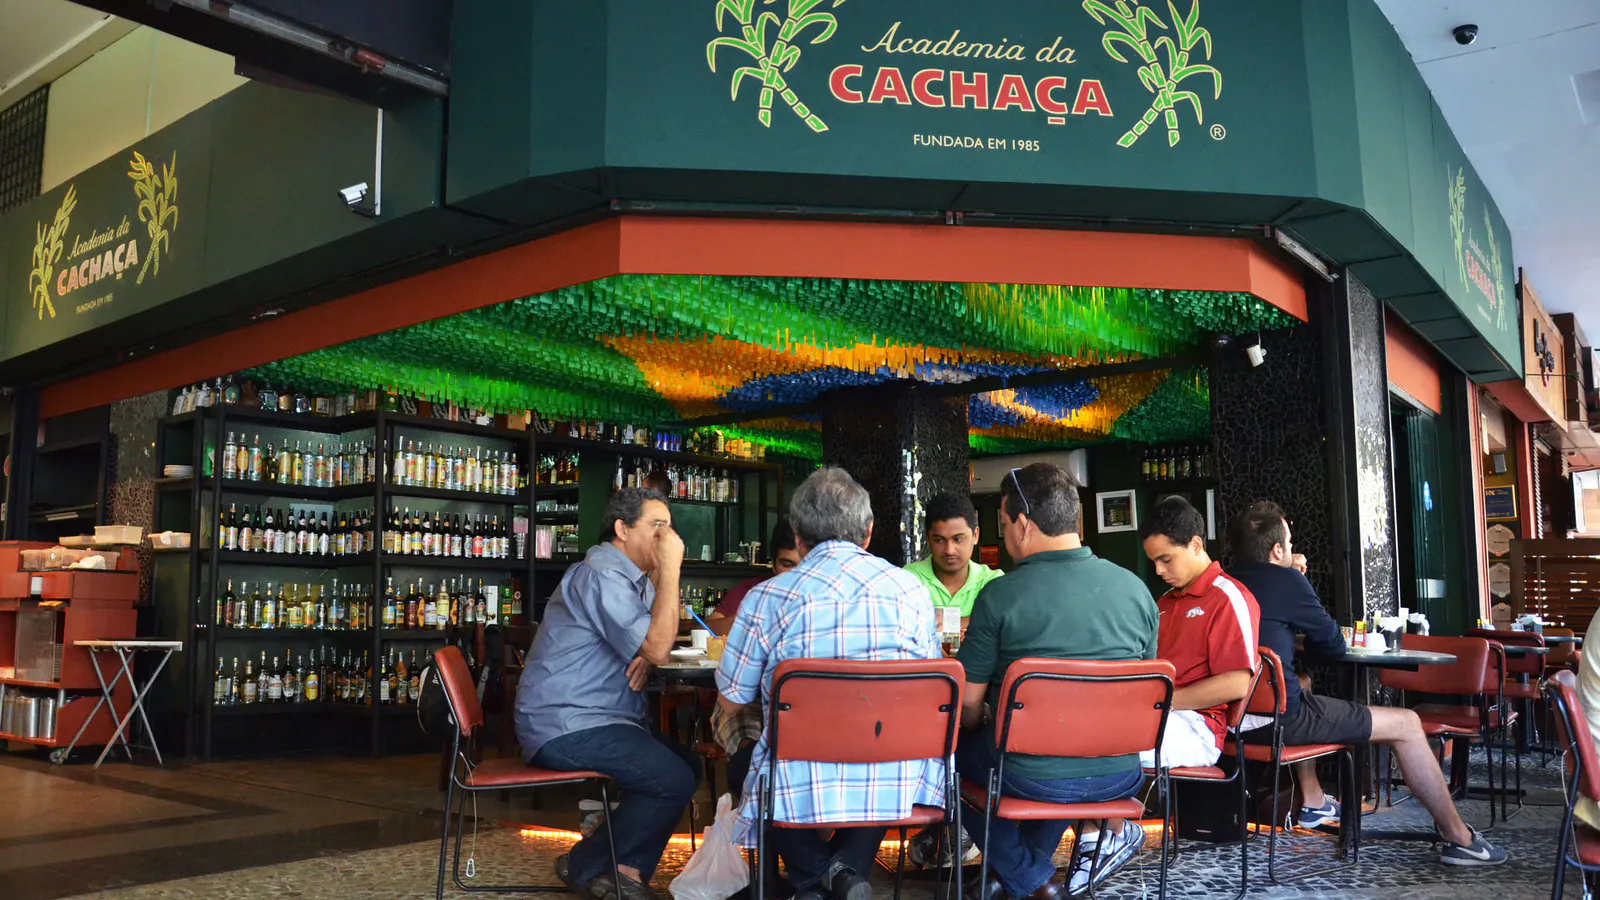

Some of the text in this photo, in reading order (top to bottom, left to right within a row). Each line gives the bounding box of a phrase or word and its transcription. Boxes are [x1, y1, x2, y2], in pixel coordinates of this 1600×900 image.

[861, 21, 1077, 64] Academia da
[829, 64, 1114, 125] CACHAÇA
[913, 134, 1040, 152] FUNDADA EM 1985
[67, 214, 130, 260] Academia da
[57, 239, 138, 296] CACHAÇA
